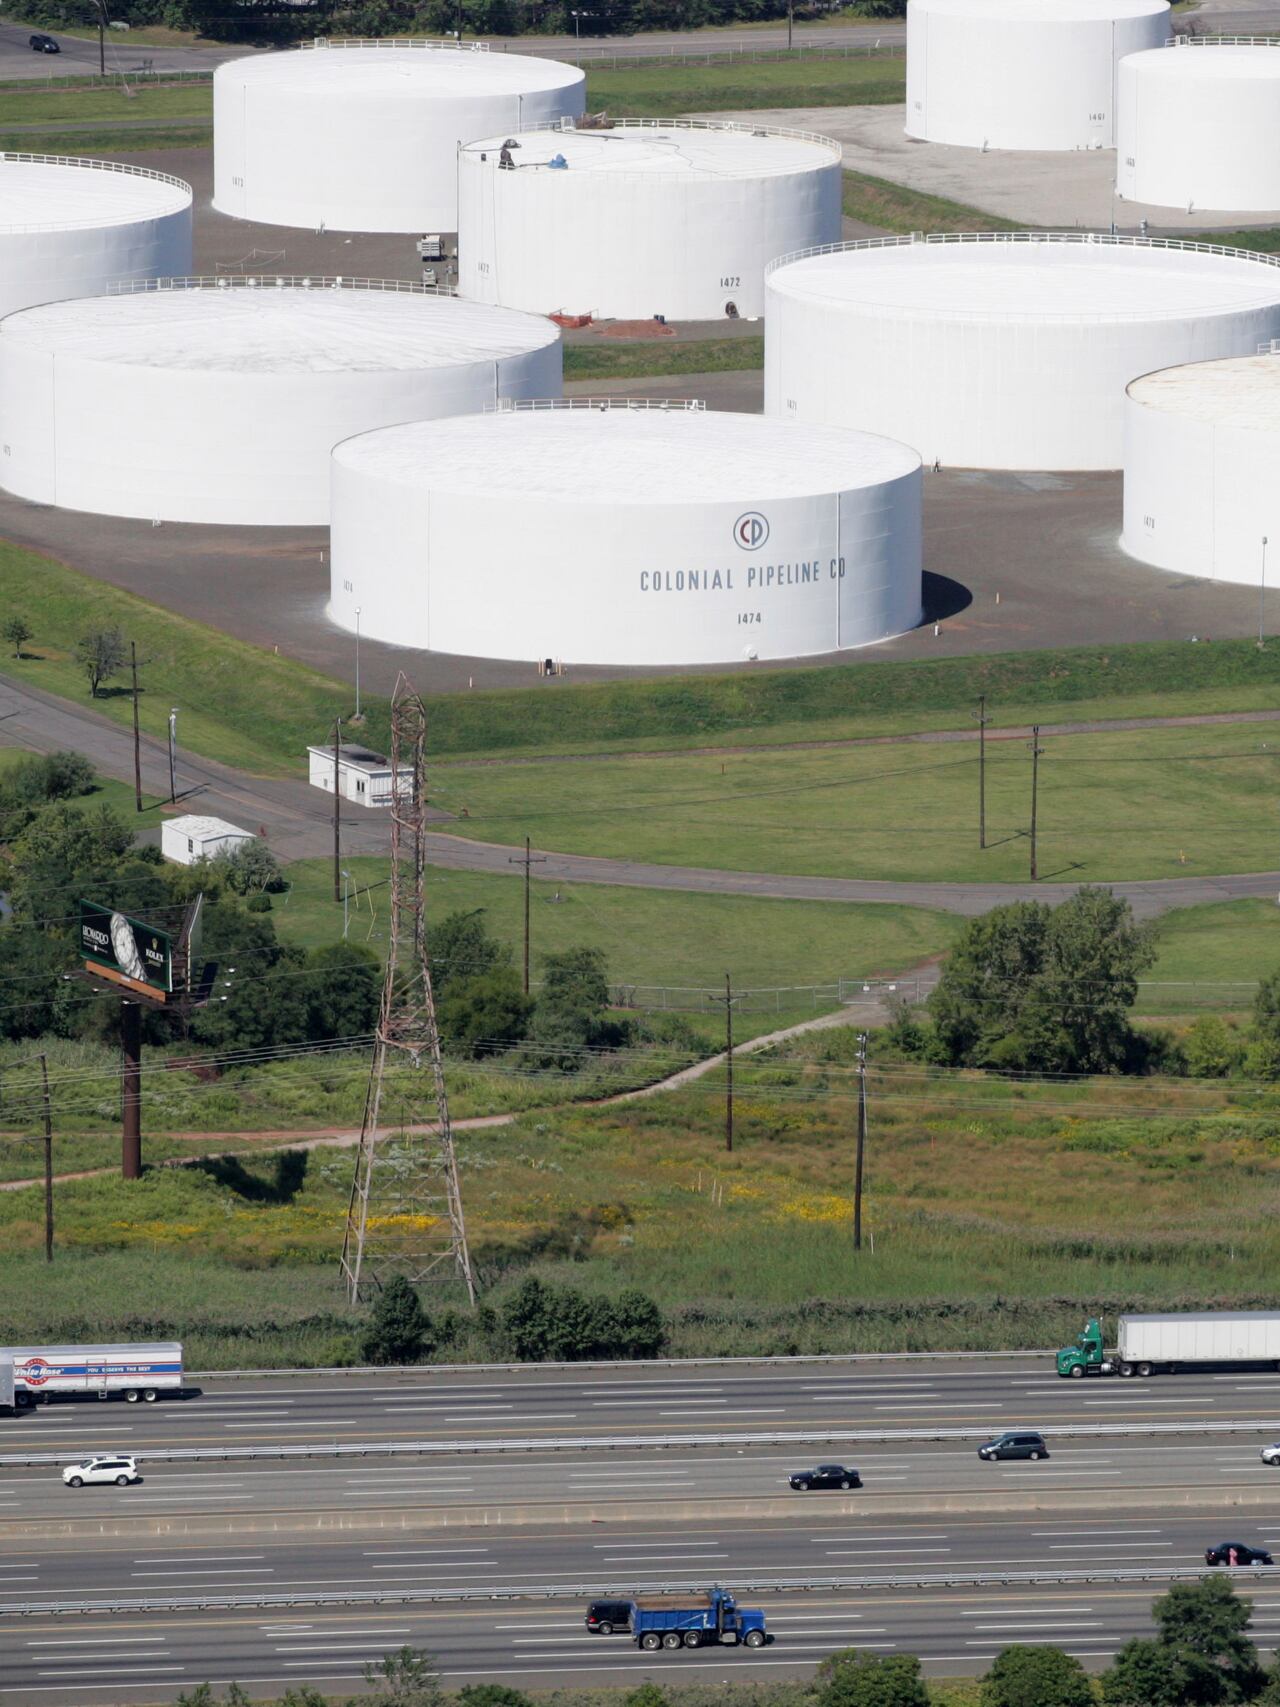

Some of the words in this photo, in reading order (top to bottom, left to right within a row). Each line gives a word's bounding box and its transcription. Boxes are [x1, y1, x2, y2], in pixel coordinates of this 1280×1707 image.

[720, 277, 741, 288] 1472
[740, 519, 763, 546] CP
[640, 568, 733, 591] COLONIAL
[747, 561, 820, 588] PIPELINE
[738, 612, 762, 625] 1474
[145, 948, 164, 964] ROLEX
